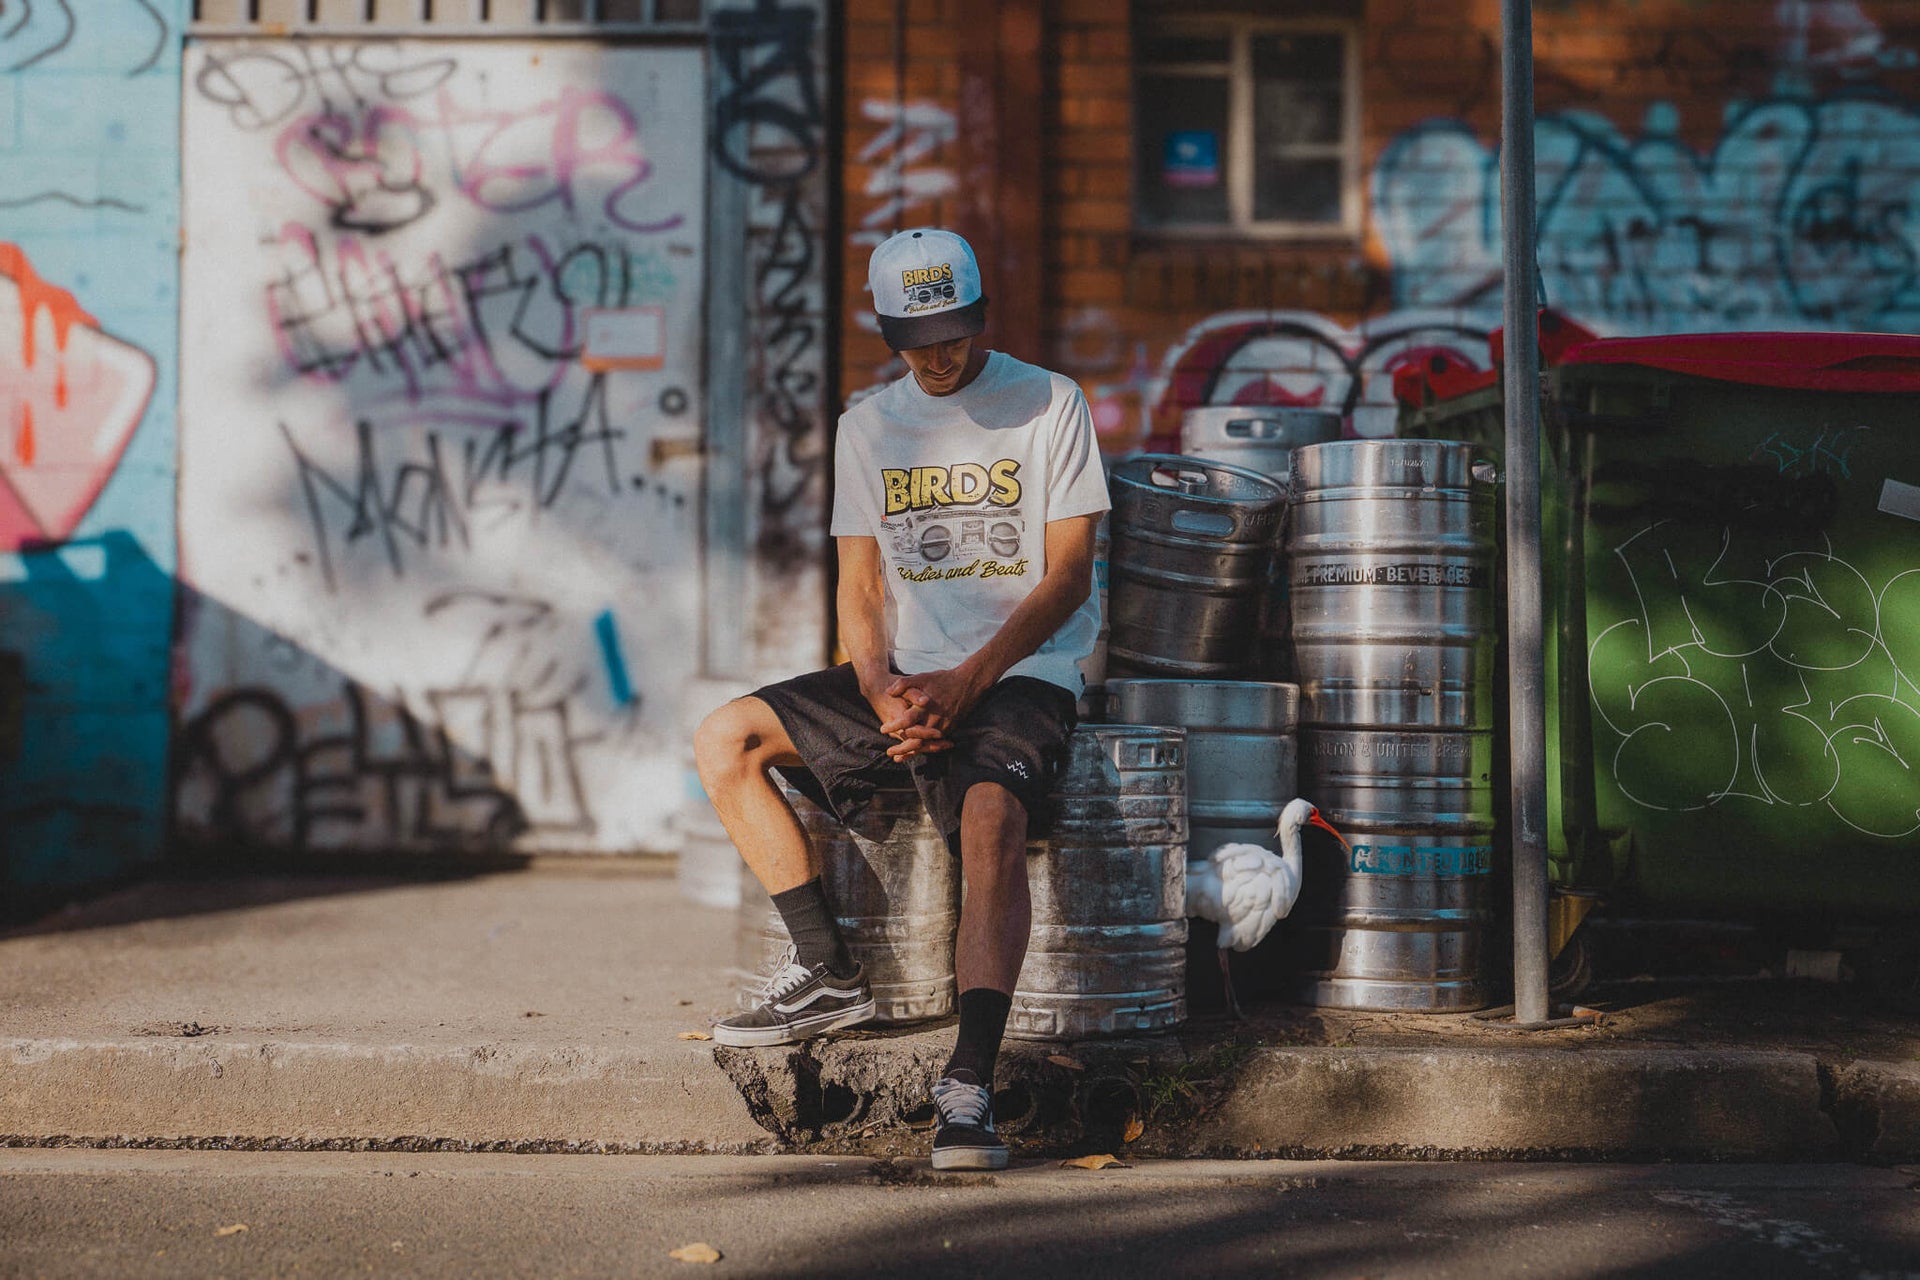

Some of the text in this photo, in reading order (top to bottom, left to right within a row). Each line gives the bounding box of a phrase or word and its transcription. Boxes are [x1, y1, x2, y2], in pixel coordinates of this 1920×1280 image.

[902, 262, 953, 287] BIRDS
[881, 458, 1022, 516] BIRDS
[945, 559, 980, 580] and
[980, 559, 1029, 579] Beats
[1313, 564, 1376, 584] PREMIUM
